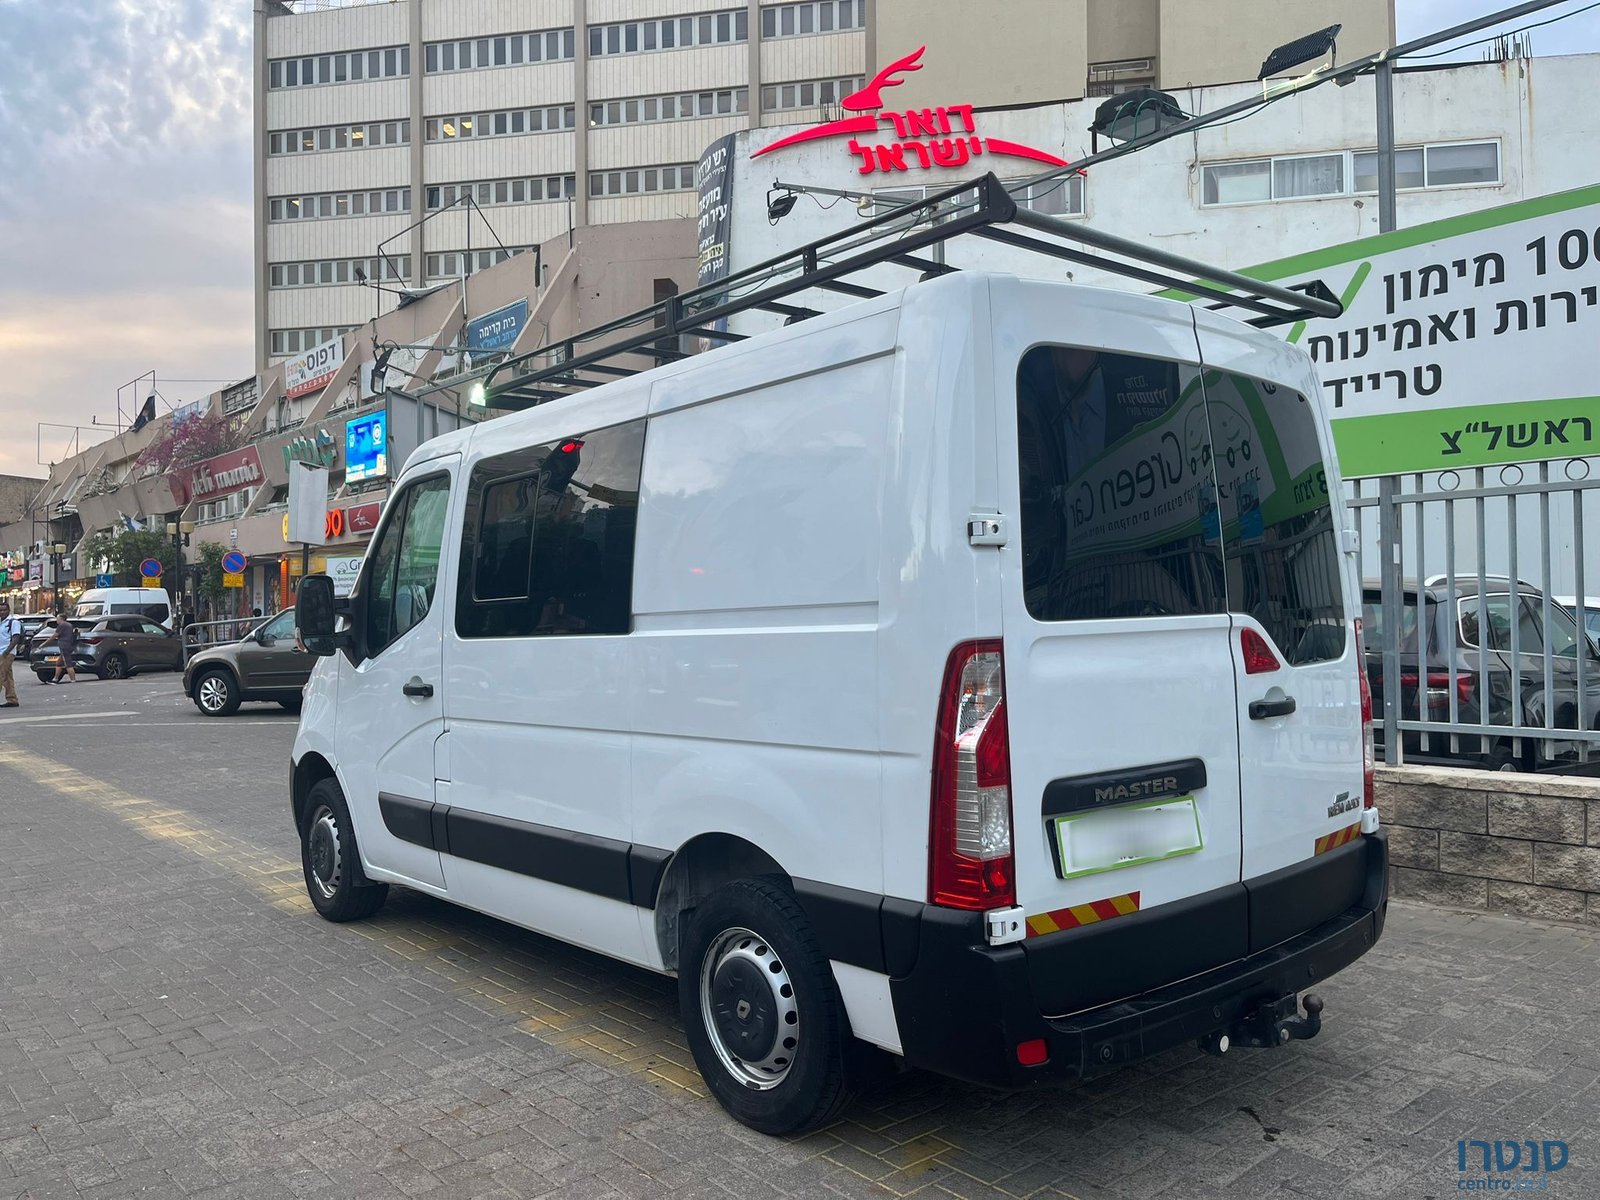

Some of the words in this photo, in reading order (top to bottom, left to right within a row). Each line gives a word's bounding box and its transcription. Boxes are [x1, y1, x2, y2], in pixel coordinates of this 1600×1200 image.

[880, 104, 975, 138] דואר
[848, 135, 983, 175] ישראל
[1526, 225, 1600, 276] 10
[1383, 252, 1505, 315] מימון
[479, 321, 501, 339] קדימה
[502, 316, 516, 330] בית
[1493, 285, 1597, 335] ירות
[1307, 306, 1475, 364] ואמינות
[306, 343, 336, 371] דפוס
[1322, 363, 1443, 408] טרייד
[1440, 416, 1592, 456] ראשל"צ
[1094, 776, 1178, 802] MASTER
